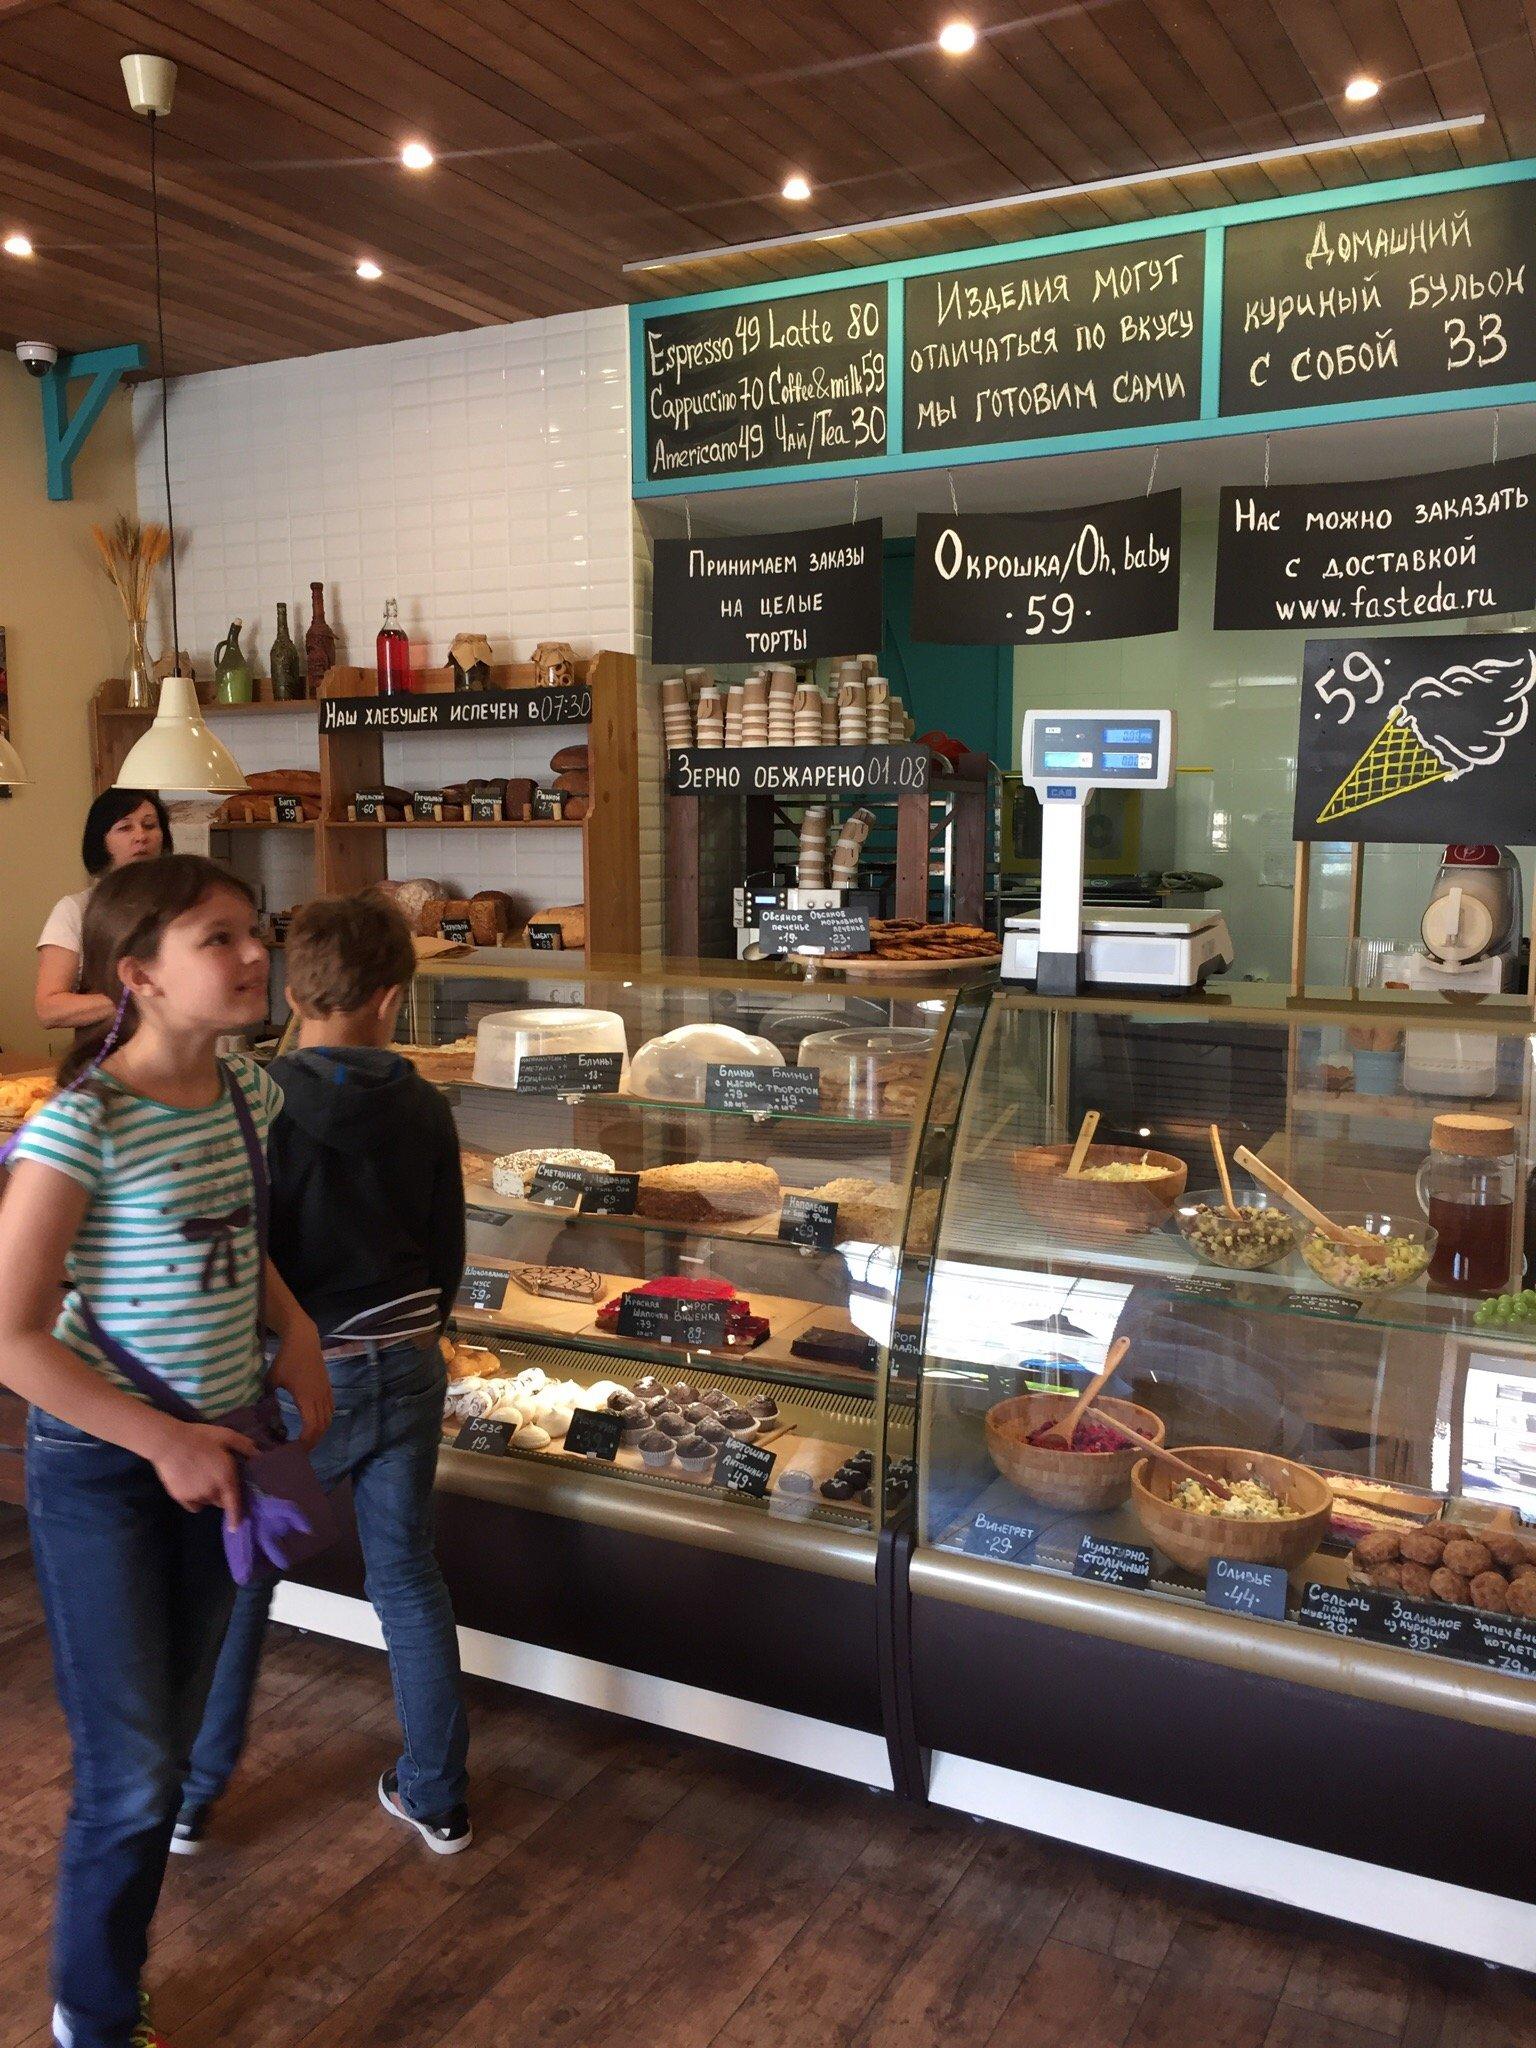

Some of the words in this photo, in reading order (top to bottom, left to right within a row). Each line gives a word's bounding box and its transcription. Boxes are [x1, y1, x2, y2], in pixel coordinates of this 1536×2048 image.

[648, 331, 733, 384] Espresso
[735, 315, 760, 355] 49
[769, 308, 833, 348] Latte
[847, 303, 878, 339] 80
[1444, 312, 1508, 372] 33
[651, 384, 737, 430] Cappuccino
[738, 378, 763, 410] 70
[862, 350, 884, 396] 59
[653, 439, 738, 473] Americano
[738, 424, 763, 461] 49
[852, 406, 885, 447] 30
[1124, 532, 1170, 574] baby
[1276, 581, 1497, 621] www.fasteda.ru
[540, 693, 591, 723] 07:30
[867, 756, 927, 788] 01.08
